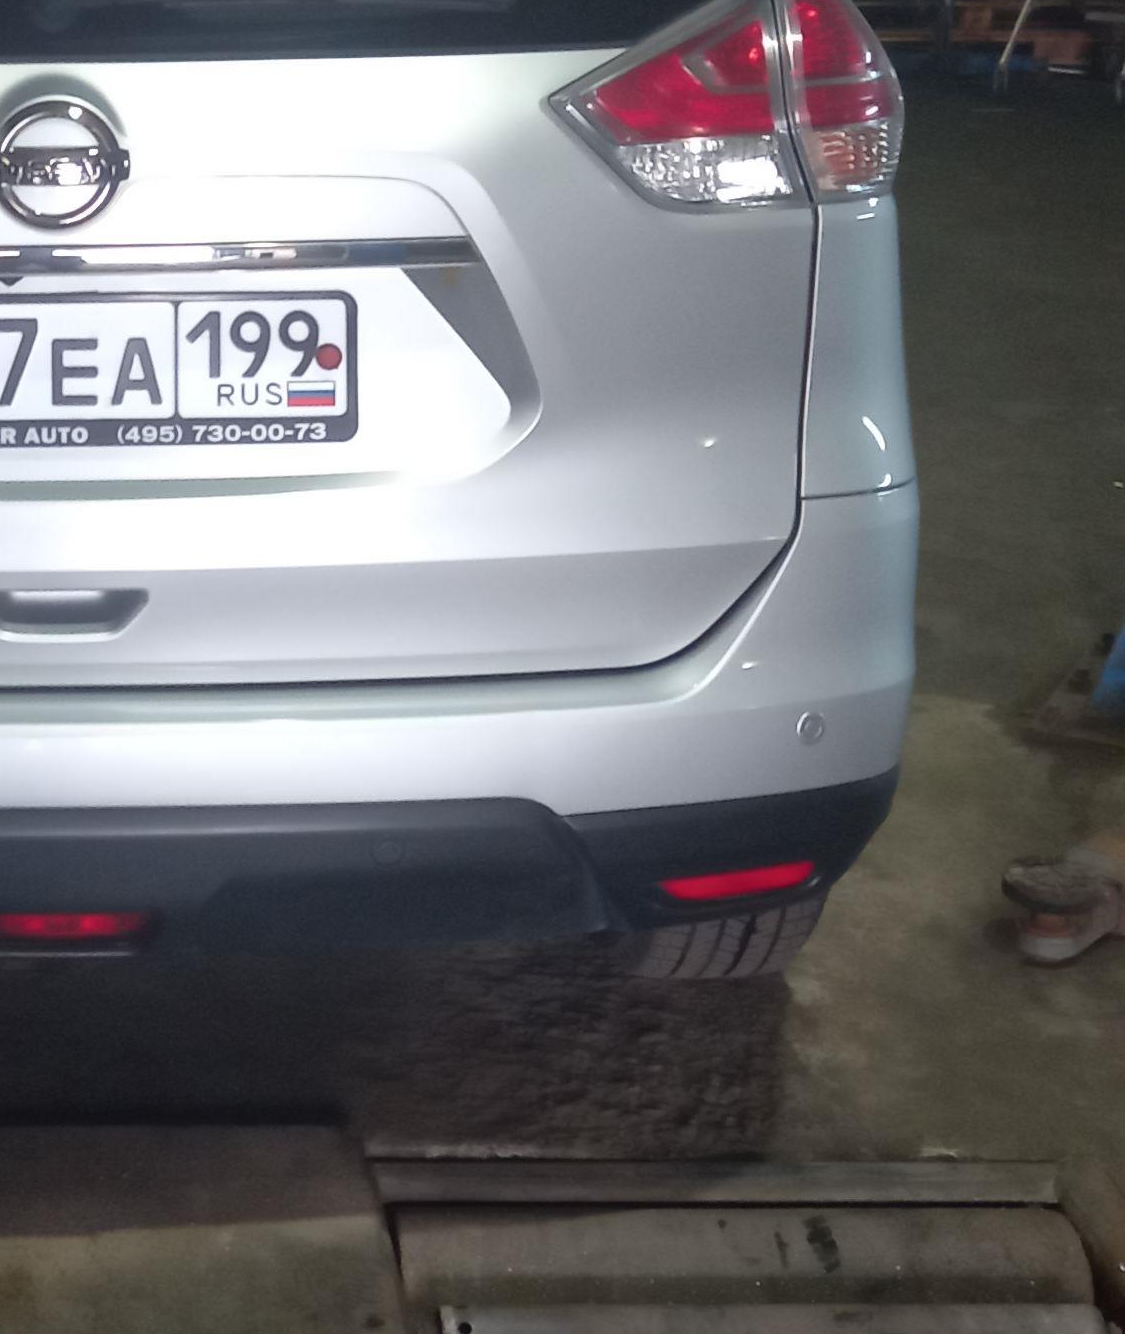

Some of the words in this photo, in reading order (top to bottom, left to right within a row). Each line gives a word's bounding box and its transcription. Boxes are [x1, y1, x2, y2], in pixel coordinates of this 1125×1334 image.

[186, 310, 321, 379] 199
[217, 383, 283, 407] RUS
[24, 425, 90, 445] AUTO
[116, 424, 183, 444] (495)
[191, 422, 328, 443] 730-00-73
